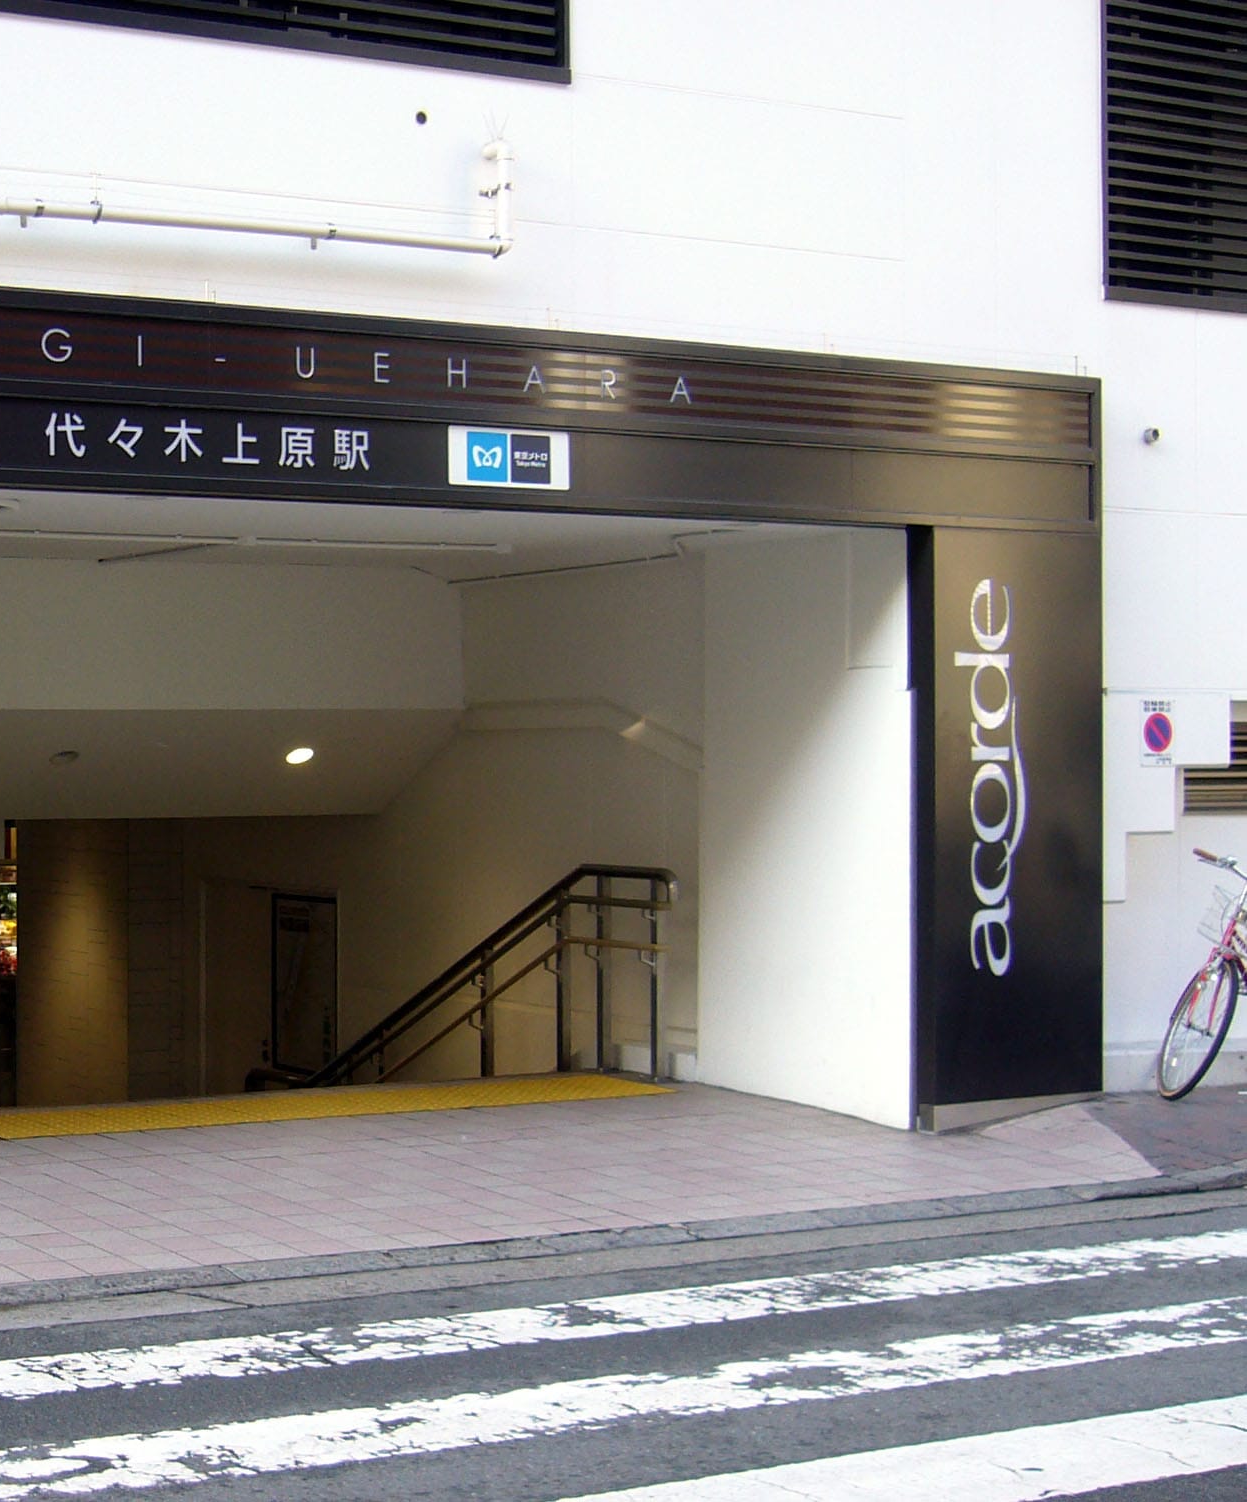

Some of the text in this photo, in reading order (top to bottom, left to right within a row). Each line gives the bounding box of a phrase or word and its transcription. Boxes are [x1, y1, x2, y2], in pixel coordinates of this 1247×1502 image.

[45, 412, 370, 471] 代々木上原駅
[954, 578, 1026, 976] acorde
